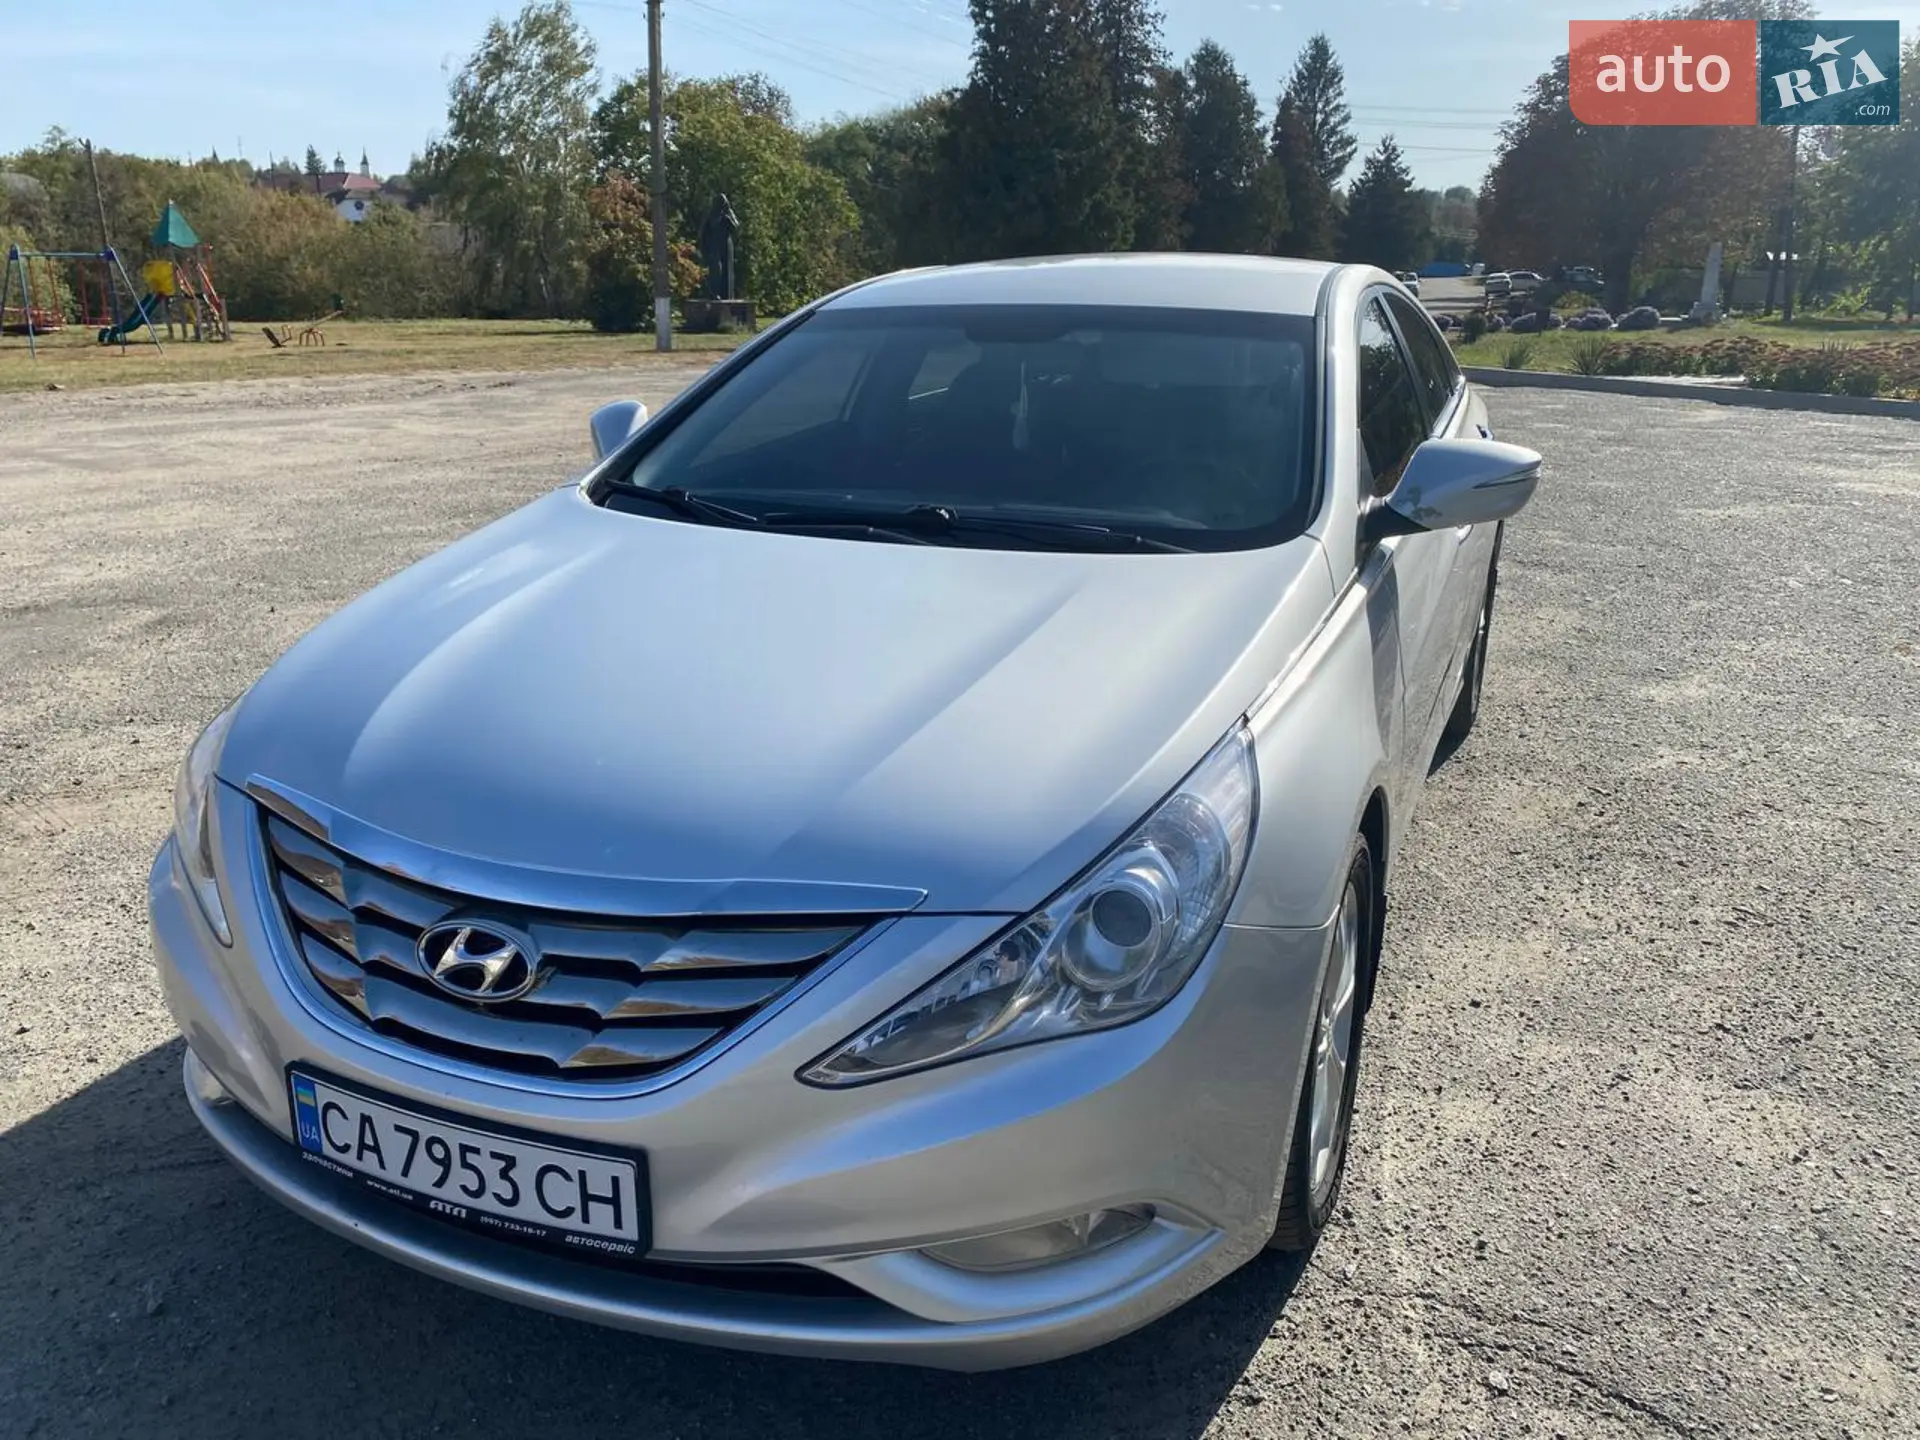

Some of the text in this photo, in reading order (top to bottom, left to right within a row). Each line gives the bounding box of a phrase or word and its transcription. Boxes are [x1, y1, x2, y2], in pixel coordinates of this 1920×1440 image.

[301, 1122, 320, 1144] UA
[321, 1101, 623, 1230] CA 7953 CH
[565, 1234, 636, 1255] автосервіс
